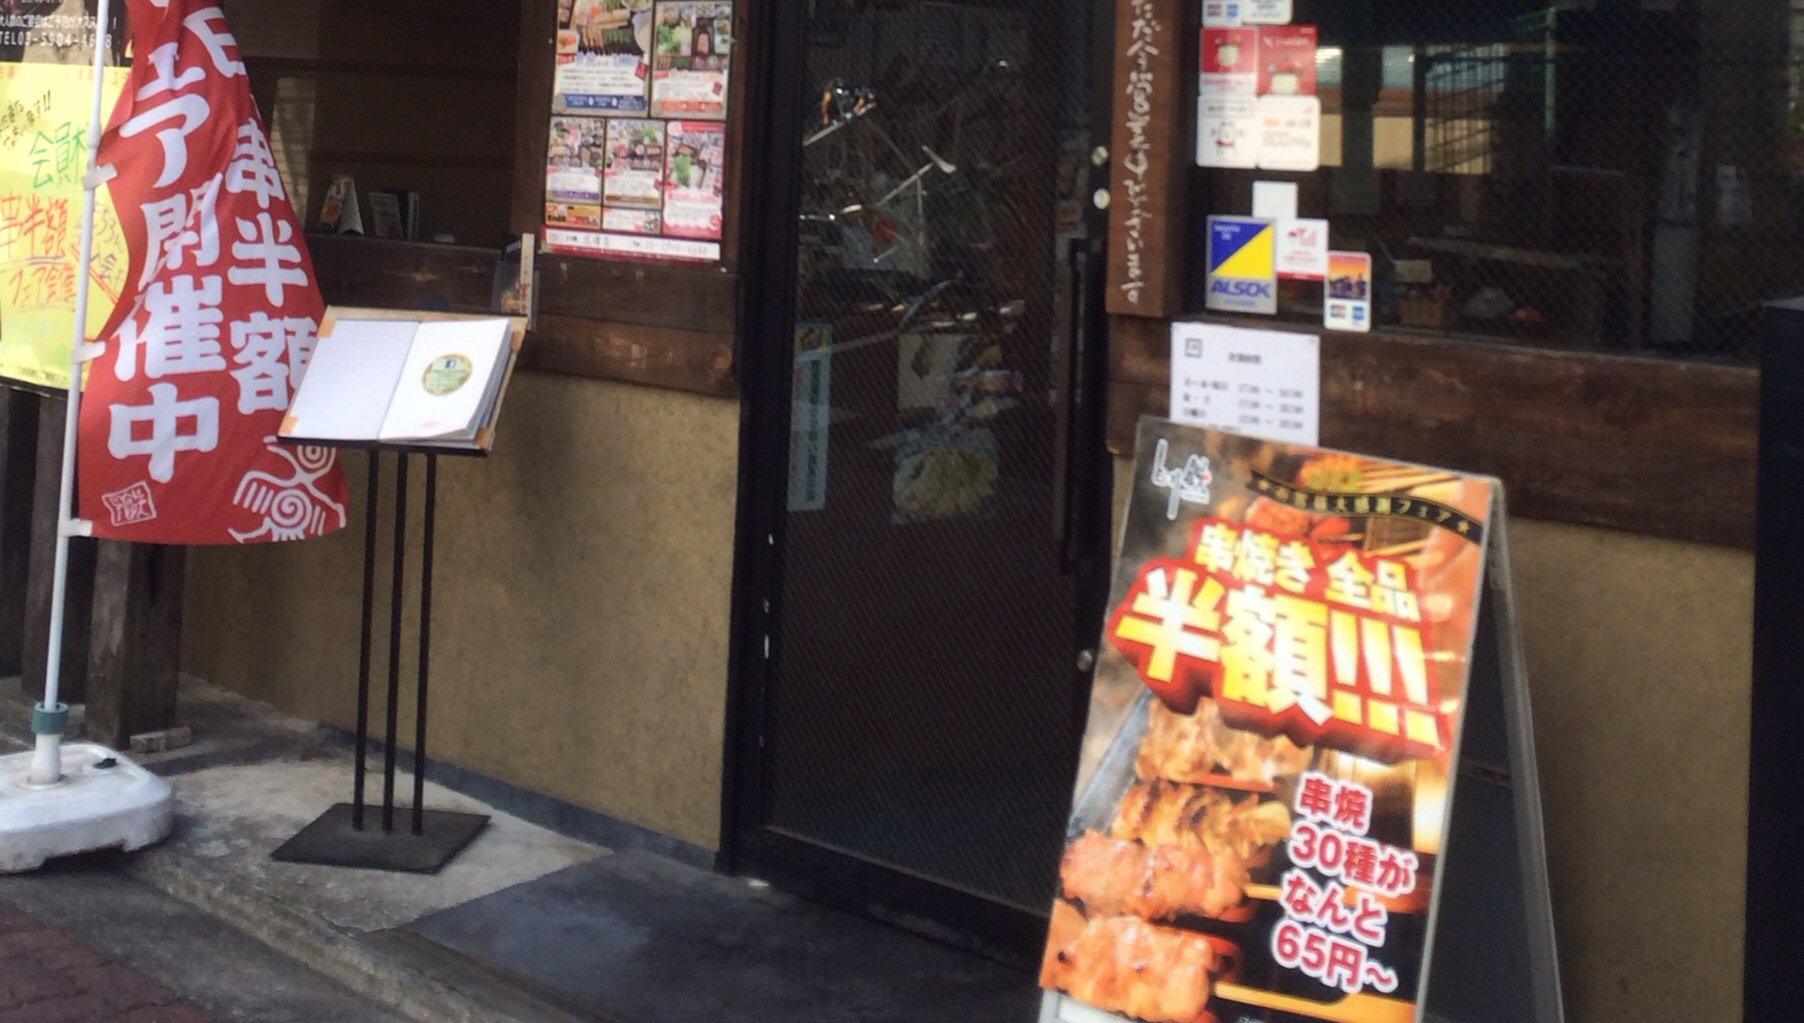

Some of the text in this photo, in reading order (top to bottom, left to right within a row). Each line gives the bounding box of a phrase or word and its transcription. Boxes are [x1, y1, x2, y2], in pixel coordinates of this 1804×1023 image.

[1211, 279, 1270, 298] ALSOK
[1194, 522, 1422, 622] 串焼き 全品
[1300, 777, 1368, 831] 串焼
[1292, 824, 1411, 893] 30種が
[1284, 872, 1384, 942] なんと
